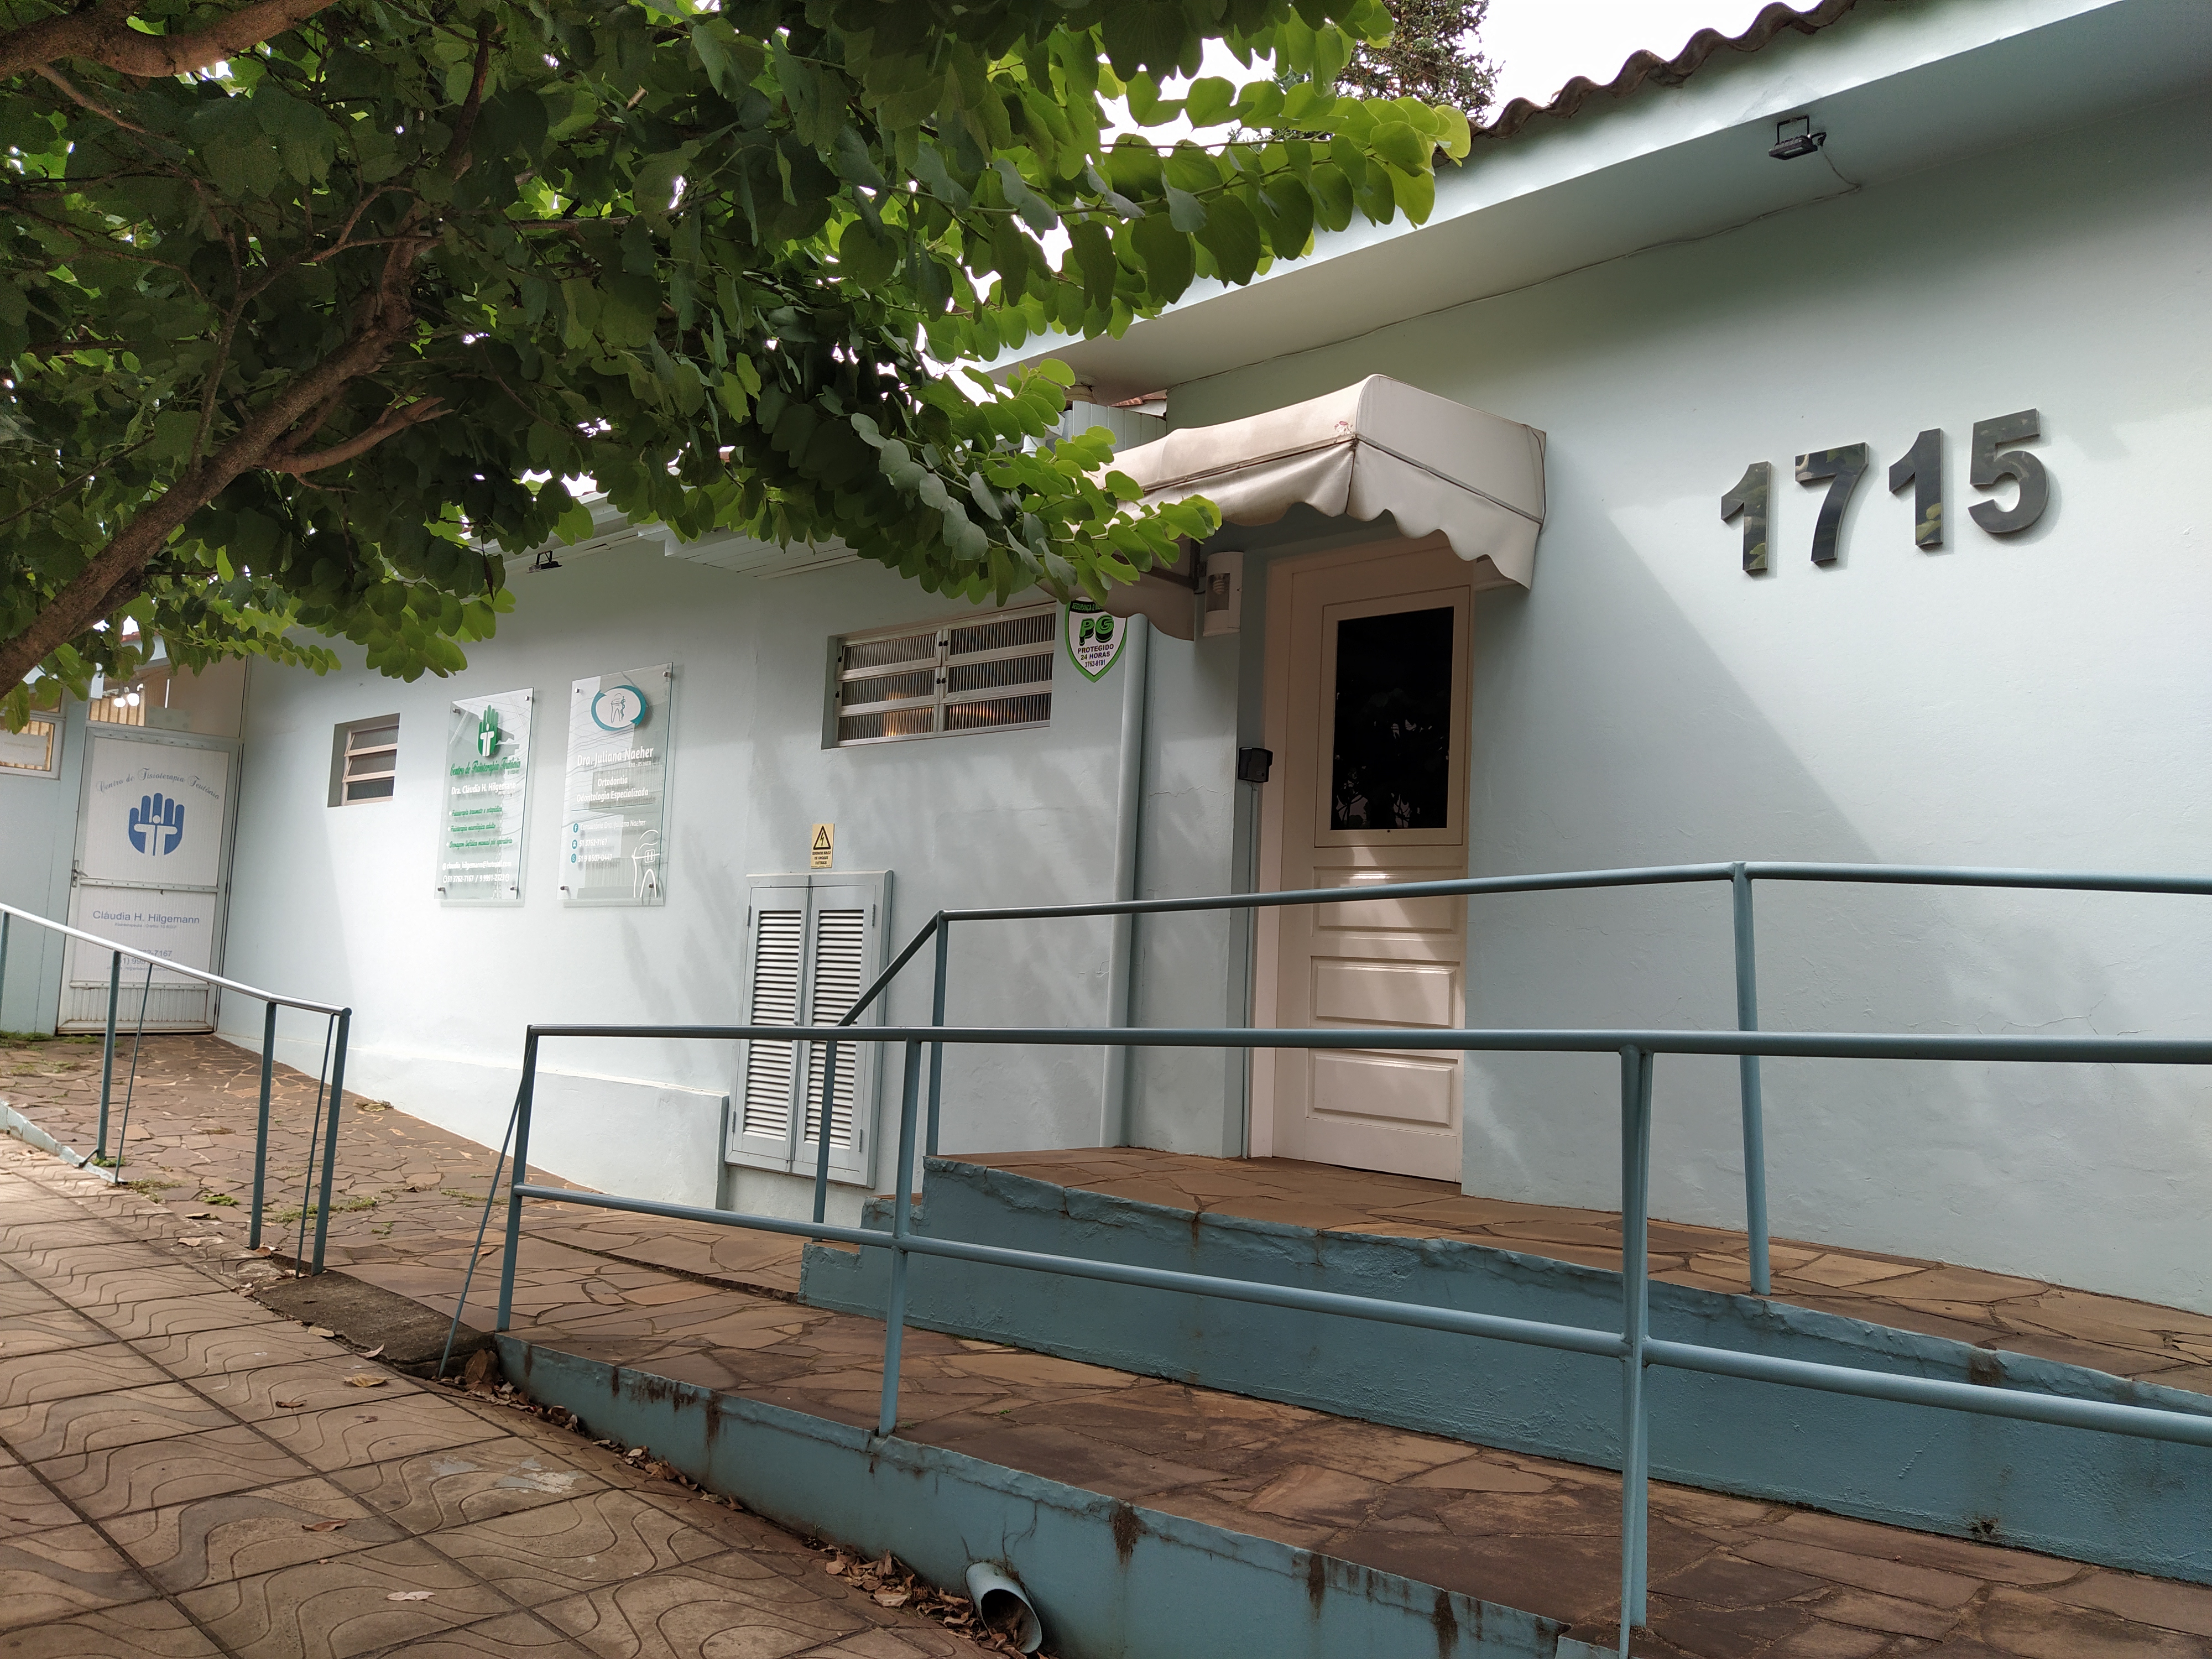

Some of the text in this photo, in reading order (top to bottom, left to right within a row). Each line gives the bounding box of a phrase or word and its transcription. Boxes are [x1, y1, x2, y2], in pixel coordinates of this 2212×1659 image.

[1721, 408, 2049, 572] 1715
[1079, 614, 1114, 646] PG
[1078, 644, 1114, 654] PROTEGIDO
[1089, 651, 1110, 659] HORAS
[1085, 659, 1106, 667] 3762-8101
[577, 746, 654, 768] Dra. Juliana Naeher
[450, 763, 464, 776] Centro
[465, 761, 471, 774] de
[472, 760, 499, 776] Fisioterapia
[96, 768, 220, 800] Centro de Fisioterapia Teutônia
[598, 776, 628, 786] Ortodontia
[451, 782, 515, 795] Dra. Cláudia H. Hilgemann
[577, 787, 649, 802] Odontologia Especializada
[581, 822, 603, 830] Consultório
[93, 910, 200, 924] Cláudia H. Hilgemann
